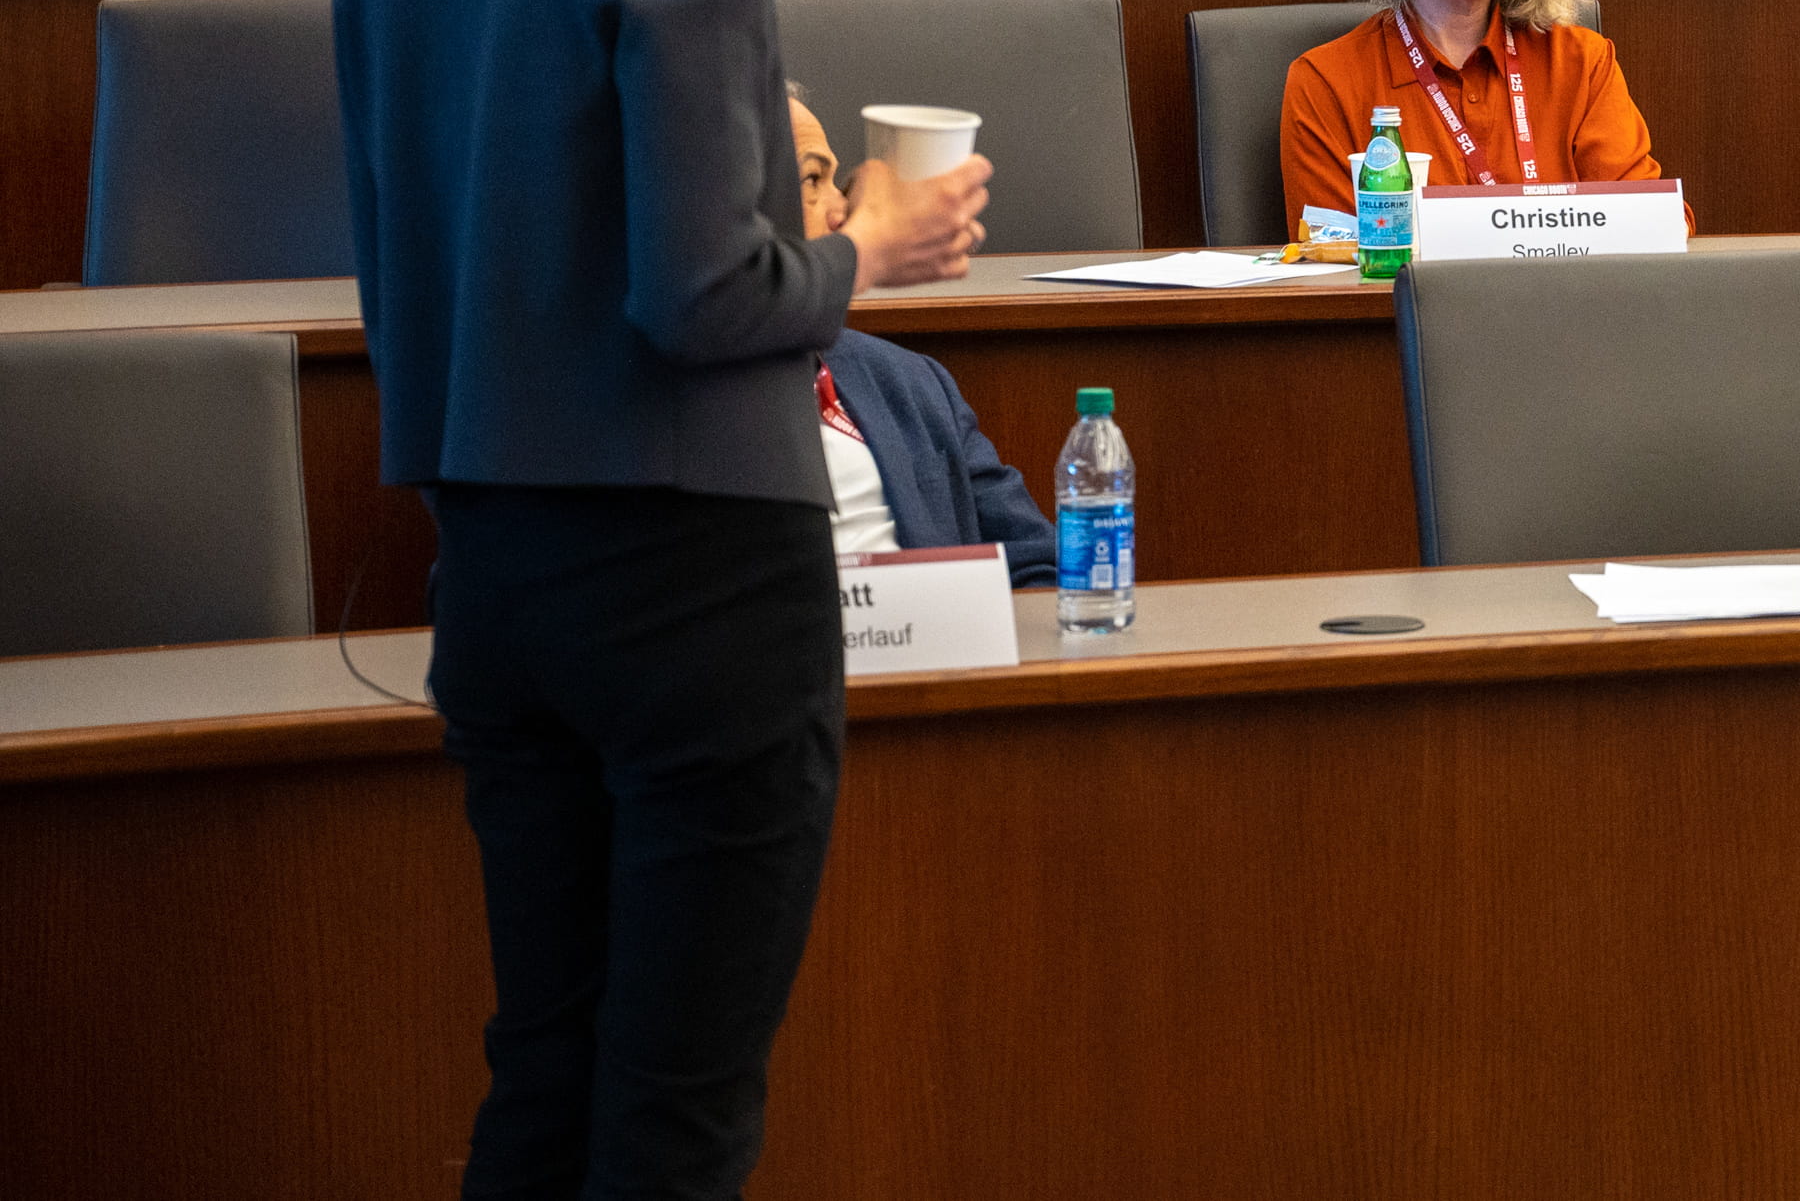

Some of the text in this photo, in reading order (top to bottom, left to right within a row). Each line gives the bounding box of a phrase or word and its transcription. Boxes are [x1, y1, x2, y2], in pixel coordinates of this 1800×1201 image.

[1408, 47, 1424, 69] 125
[1510, 73, 1523, 92] 125
[1456, 133, 1476, 155] 125
[1523, 159, 1538, 179] 125
[1491, 207, 1607, 229] Christine
[839, 583, 873, 607] att
